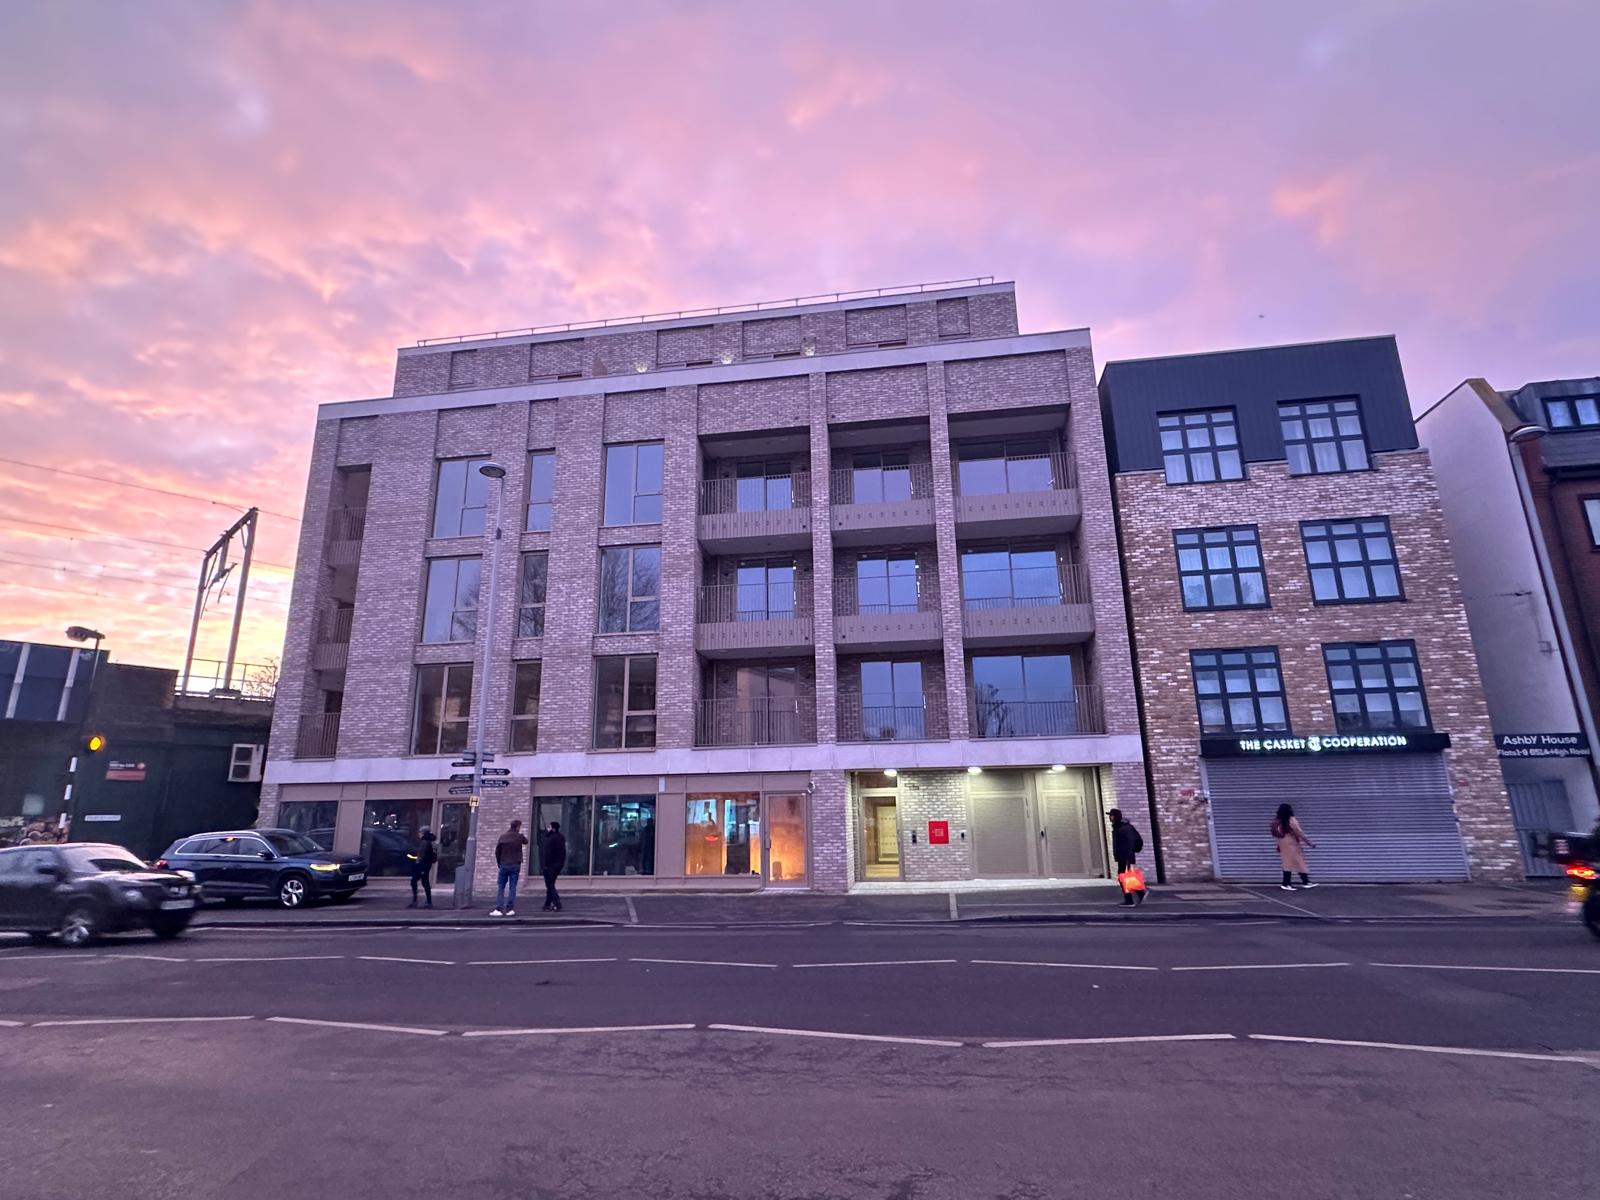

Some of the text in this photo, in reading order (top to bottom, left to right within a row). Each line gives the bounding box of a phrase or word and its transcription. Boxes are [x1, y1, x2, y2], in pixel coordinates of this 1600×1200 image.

[1240, 740, 1261, 750] THE
[1263, 739, 1306, 750] CASKET
[1322, 735, 1407, 748] COOPERATION
[1541, 735, 1578, 744] House
